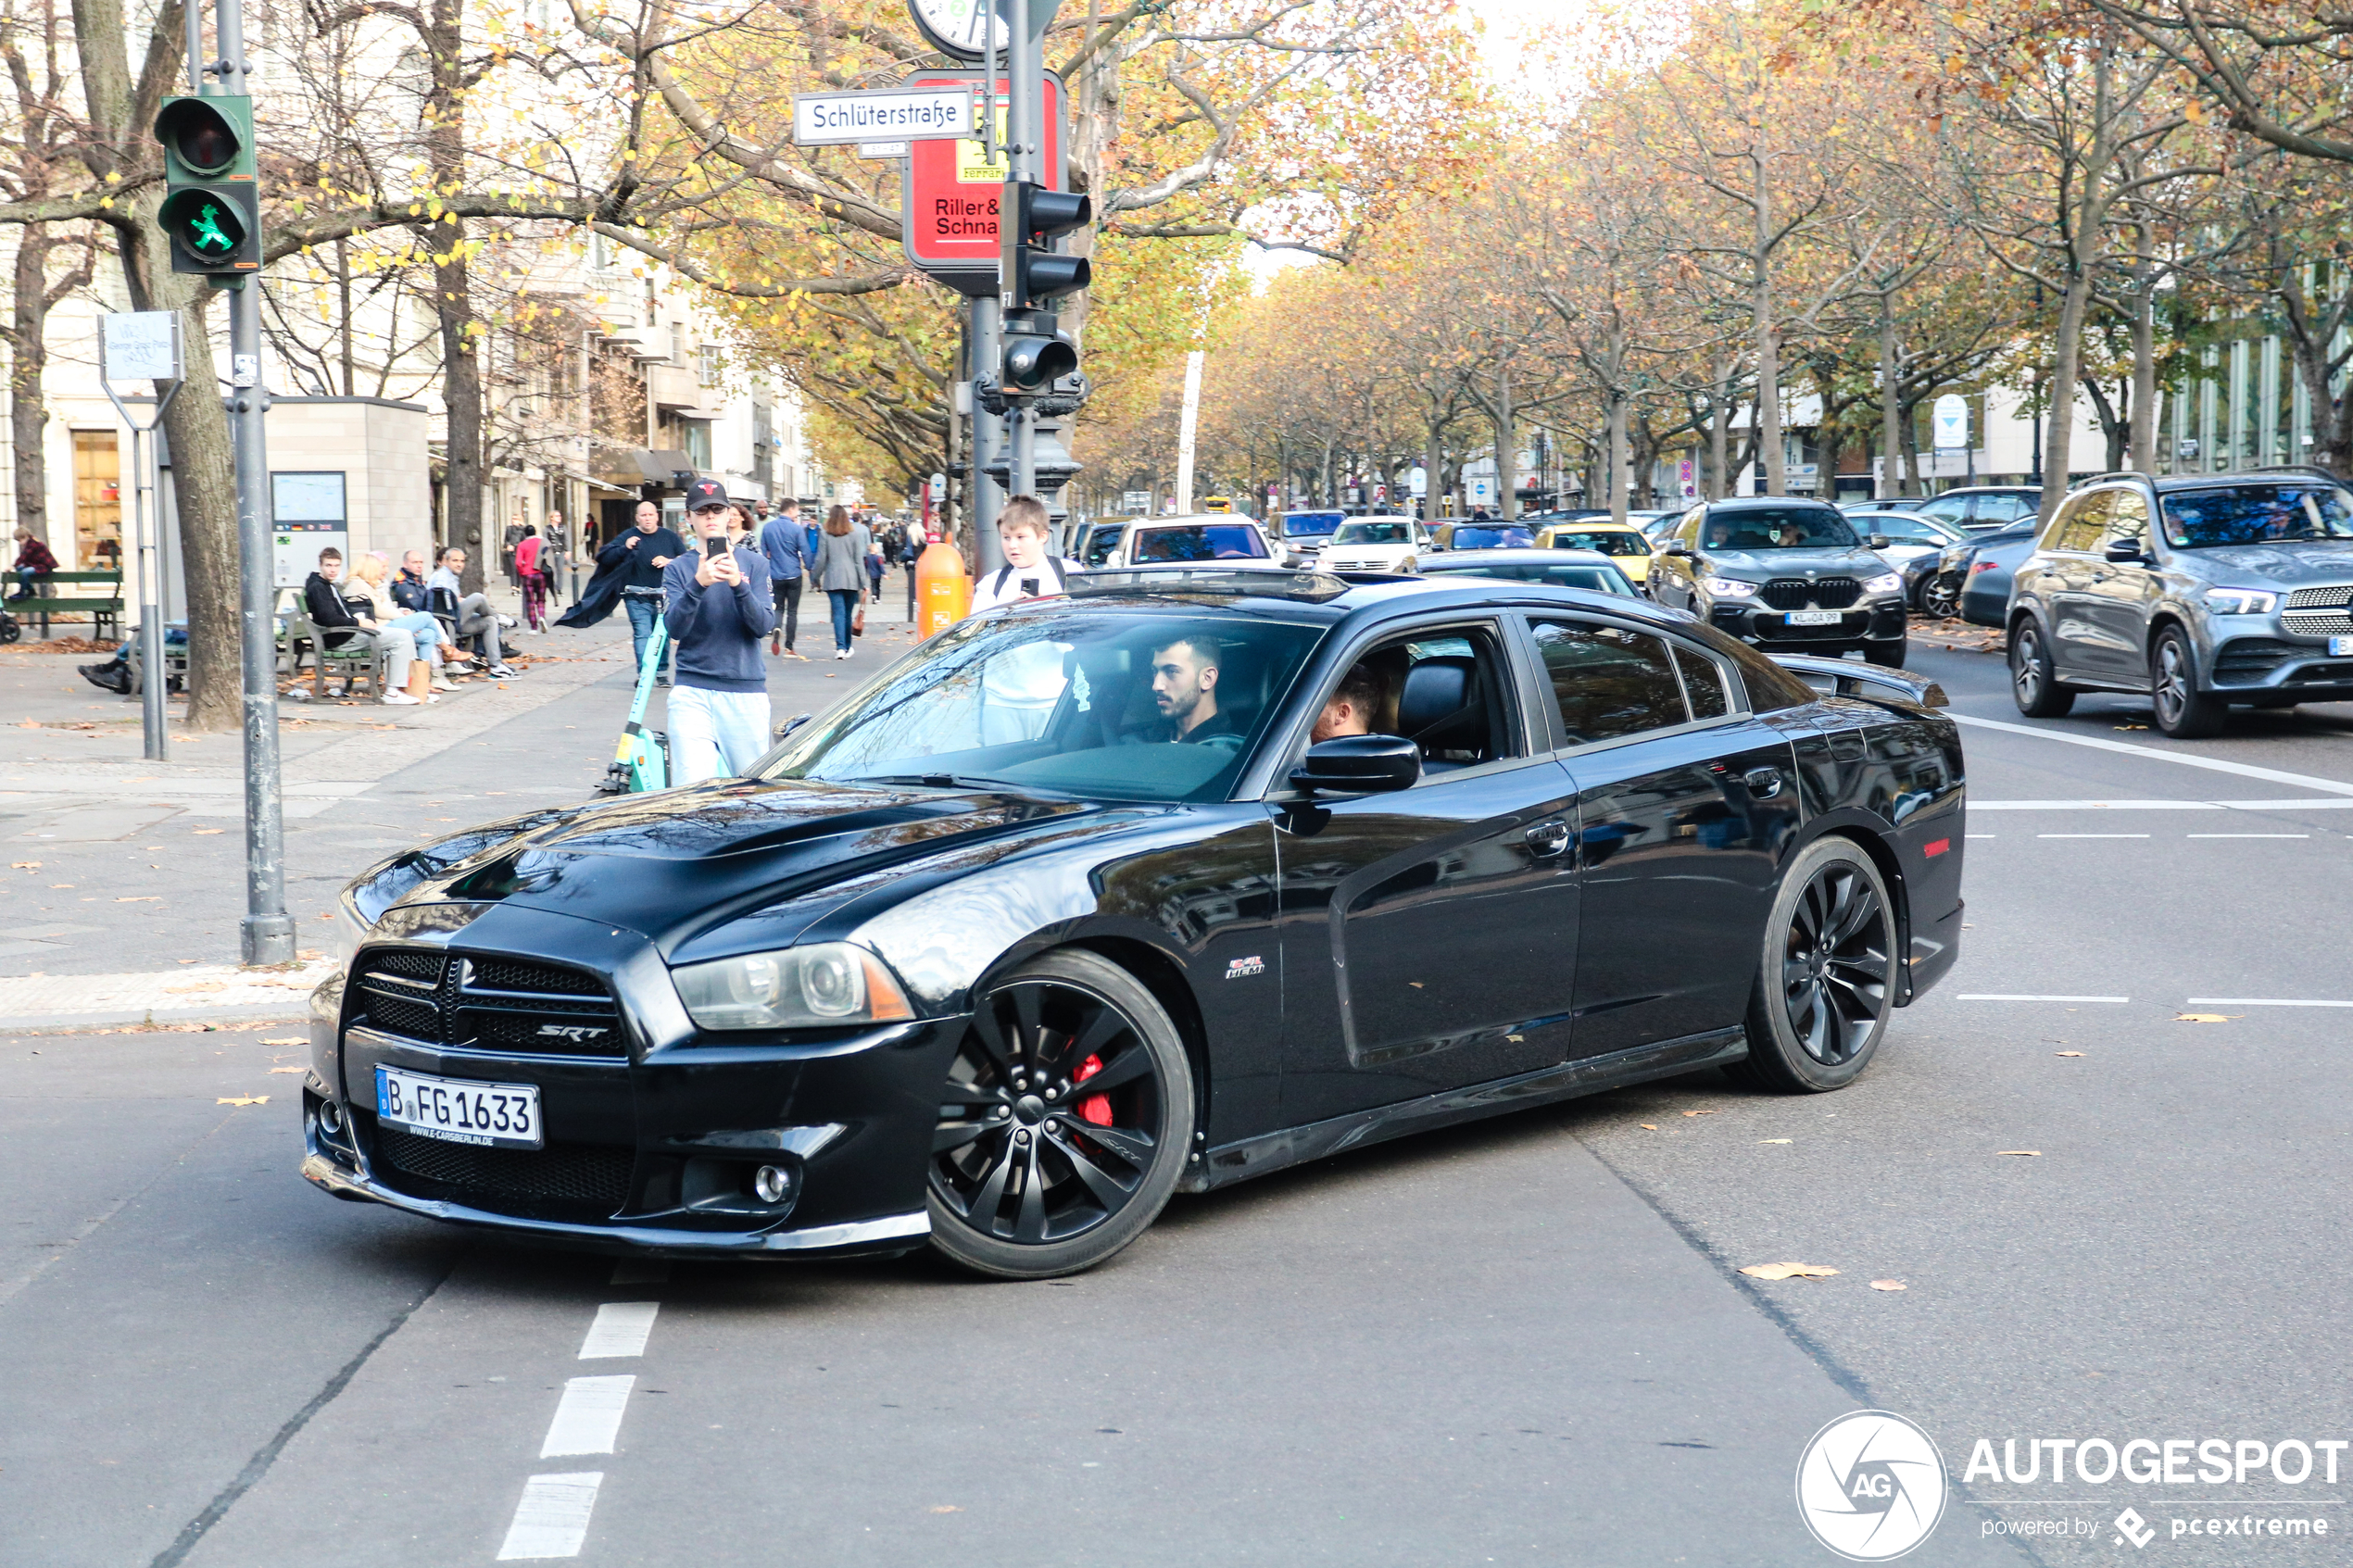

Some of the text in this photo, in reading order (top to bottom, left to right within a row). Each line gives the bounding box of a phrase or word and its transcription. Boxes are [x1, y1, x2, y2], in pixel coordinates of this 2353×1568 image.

[813, 99, 957, 128] Schlüterstraße
[936, 199, 984, 216] Riller
[536, 1024, 610, 1043] SRT
[388, 1079, 404, 1116] B
[409, 1124, 495, 1147] WWW.E-CARSBERLIN.DE
